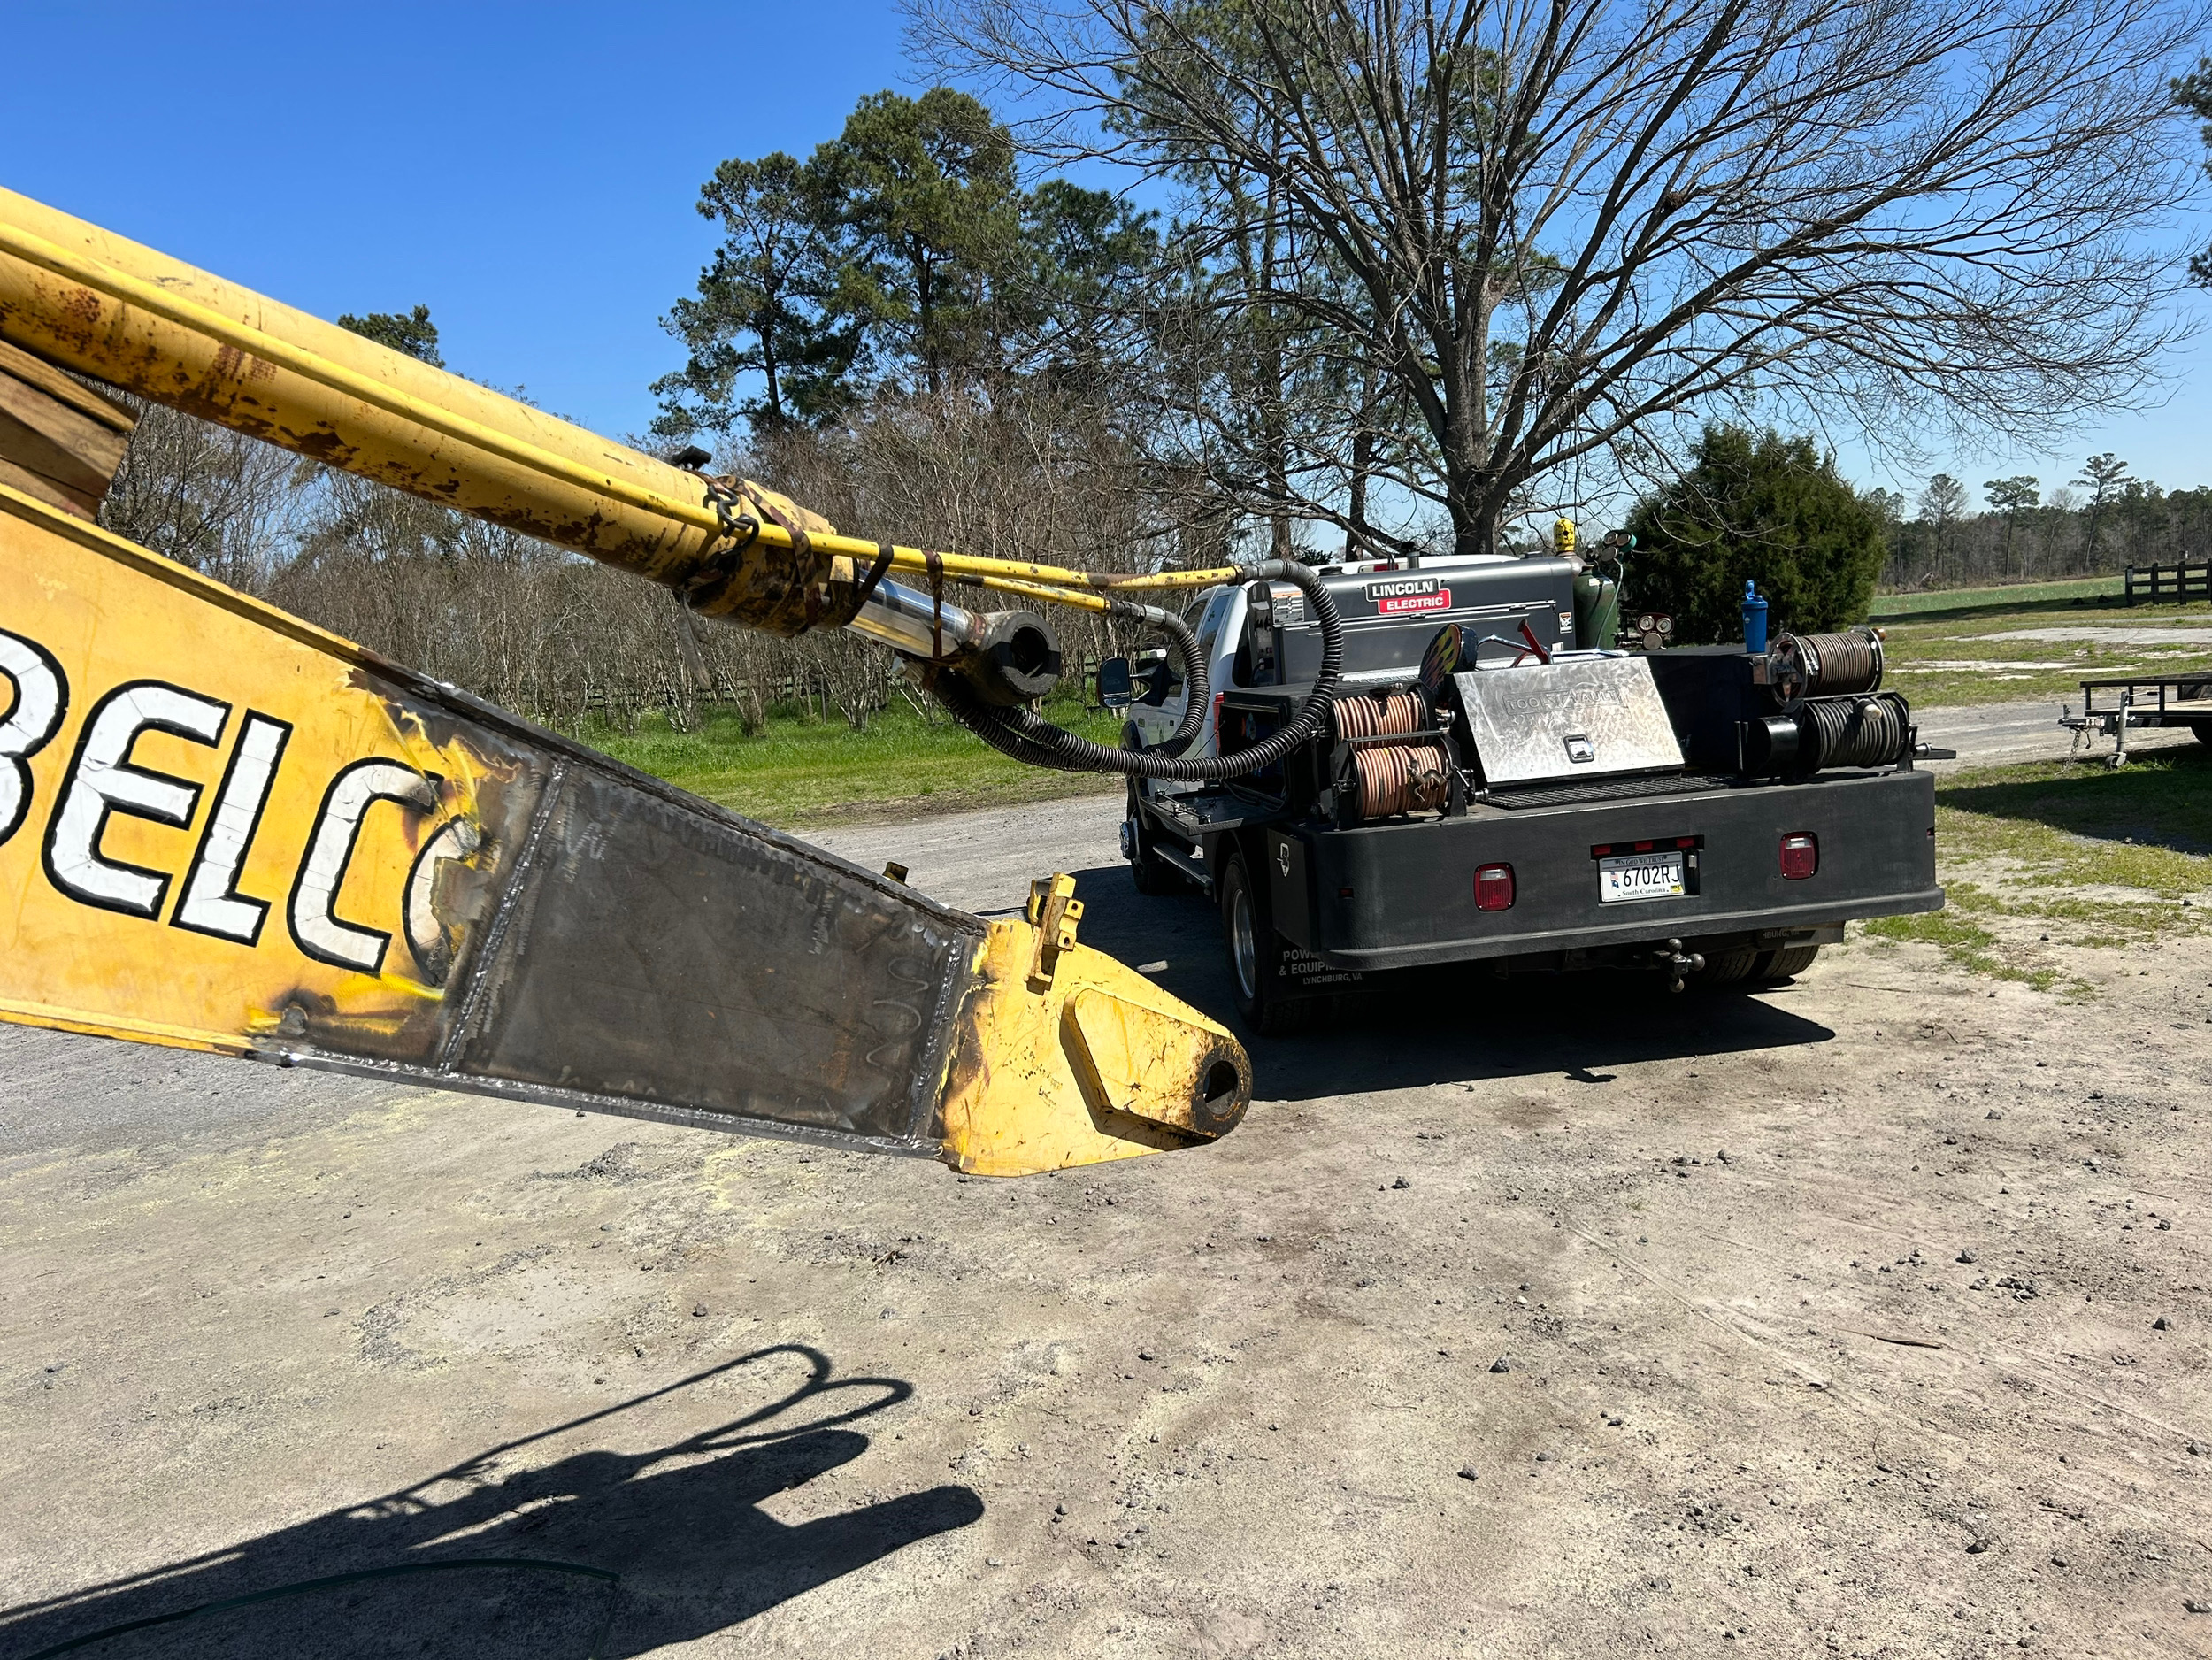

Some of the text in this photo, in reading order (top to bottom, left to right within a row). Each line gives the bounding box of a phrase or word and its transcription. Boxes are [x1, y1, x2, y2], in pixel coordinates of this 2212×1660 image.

[1372, 580, 1433, 597] LINCOLN
[1386, 596, 1444, 611] ELECTRIC
[1623, 864, 1679, 887] 6702RJ
[1622, 888, 1639, 897] South
[1283, 949, 1313, 962] POW
[1279, 965, 1287, 976] &
[1302, 972, 1352, 985] LYNCHBURG,
